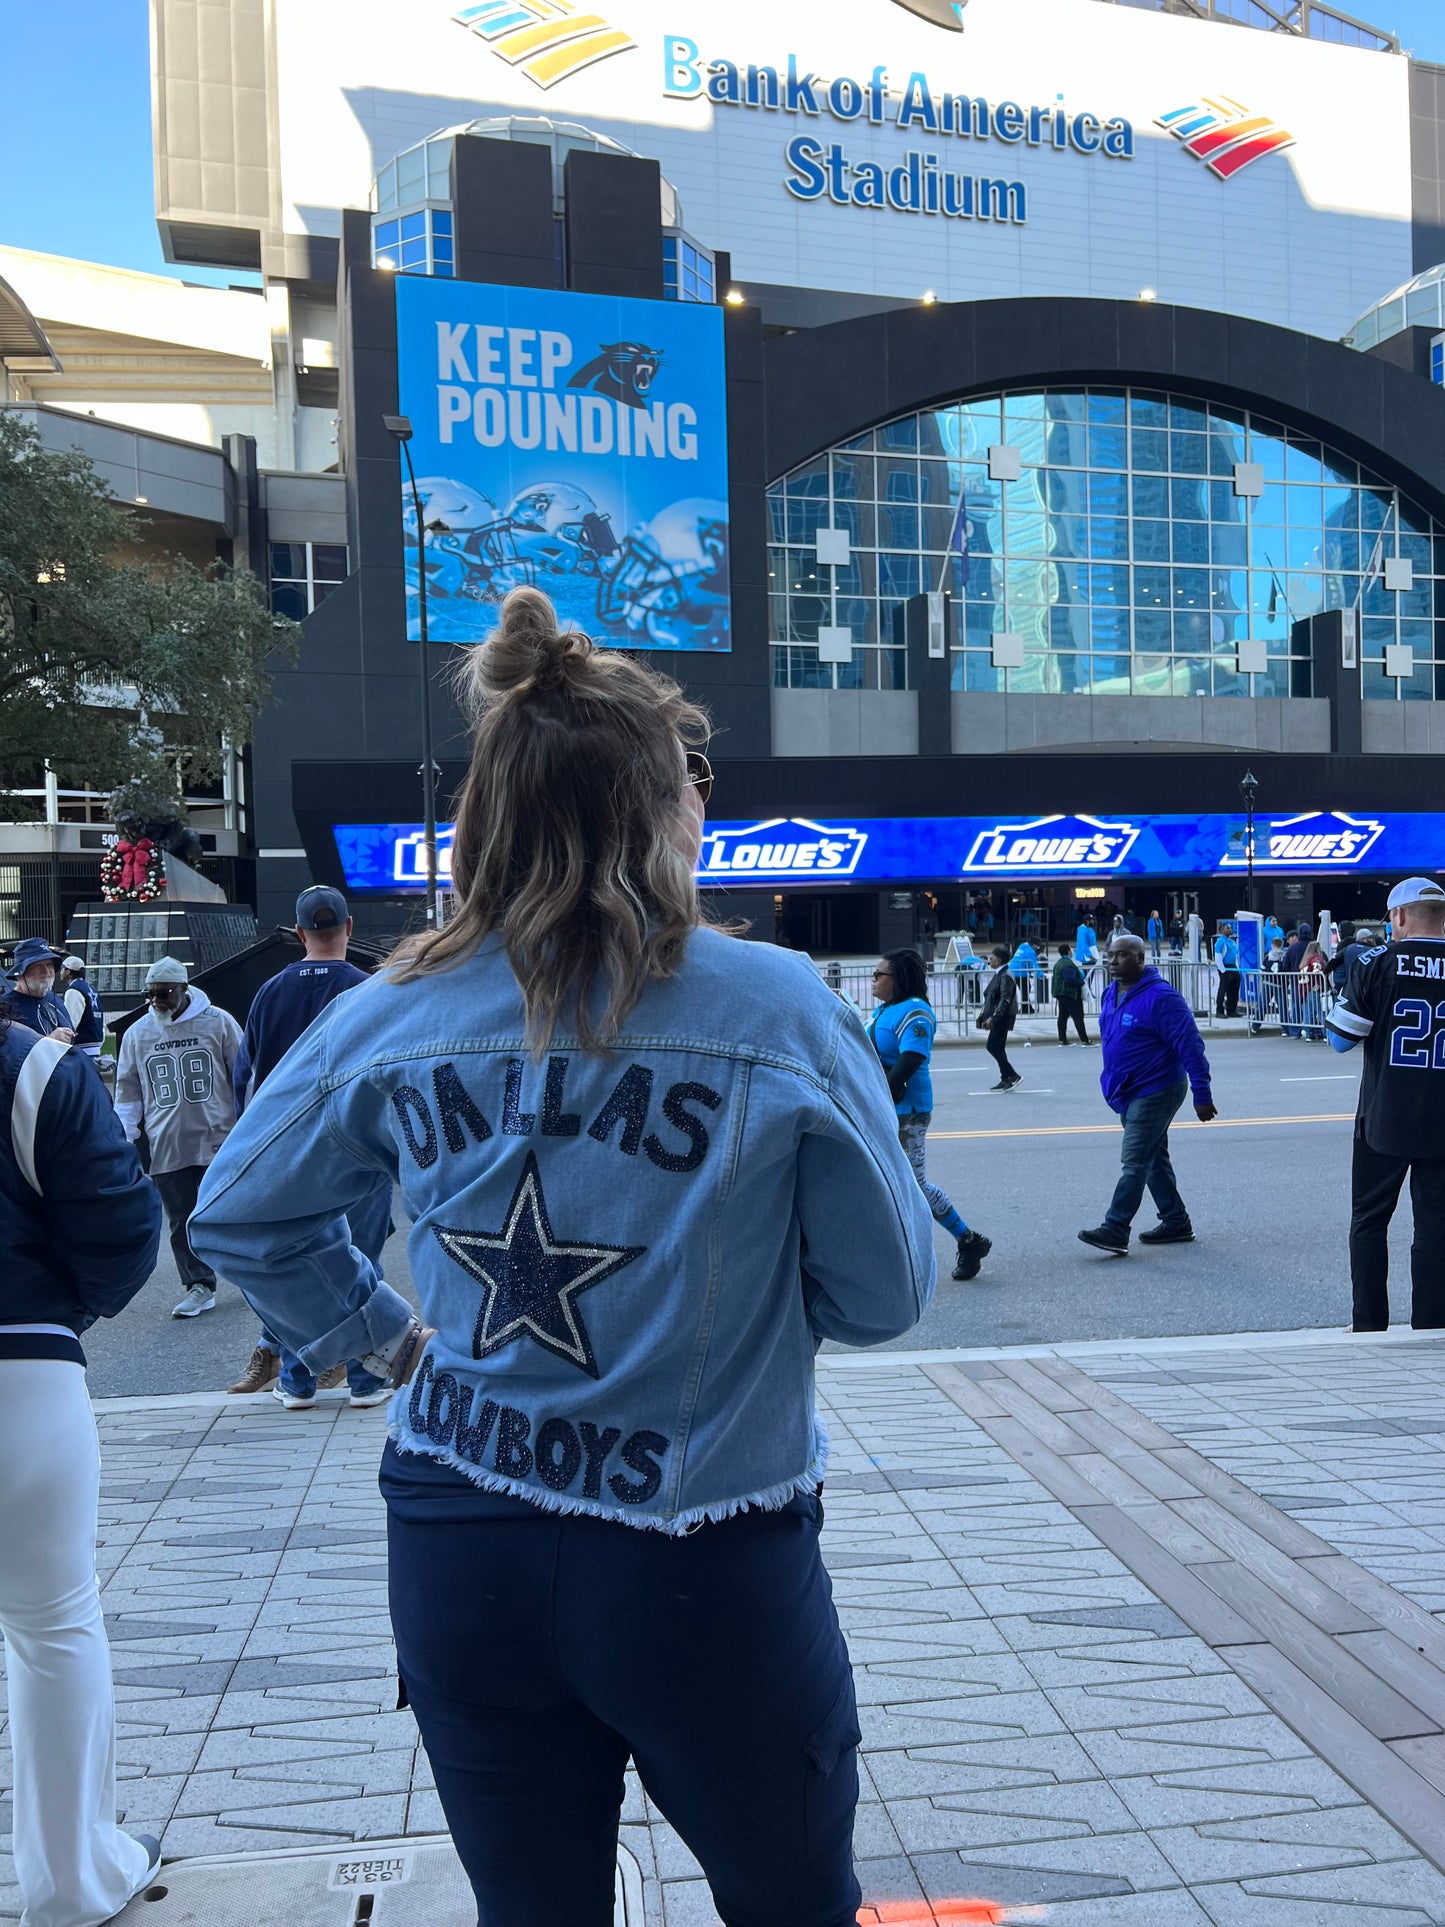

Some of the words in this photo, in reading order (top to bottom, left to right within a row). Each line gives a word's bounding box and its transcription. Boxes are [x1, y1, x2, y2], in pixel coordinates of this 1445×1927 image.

[663, 34, 820, 114] Bank
[829, 65, 888, 123] of
[897, 71, 1136, 159] America
[784, 134, 1027, 224] Stadium
[435, 321, 573, 388] KEEP
[436, 384, 698, 461] POUNDING
[708, 838, 845, 869] LOWE'S
[984, 834, 1117, 864] LOWE'S
[1270, 830, 1362, 858] OWE'S
[154, 1037, 199, 1052] COWBOYS
[146, 1048, 213, 1109] 88
[391, 1056, 723, 1173] DALLAS
[408, 1353, 672, 1505] COWBOYS
[338, 1859, 403, 1876] TIER22
[343, 1874, 358, 1885] K
[364, 1871, 393, 1883] 33
